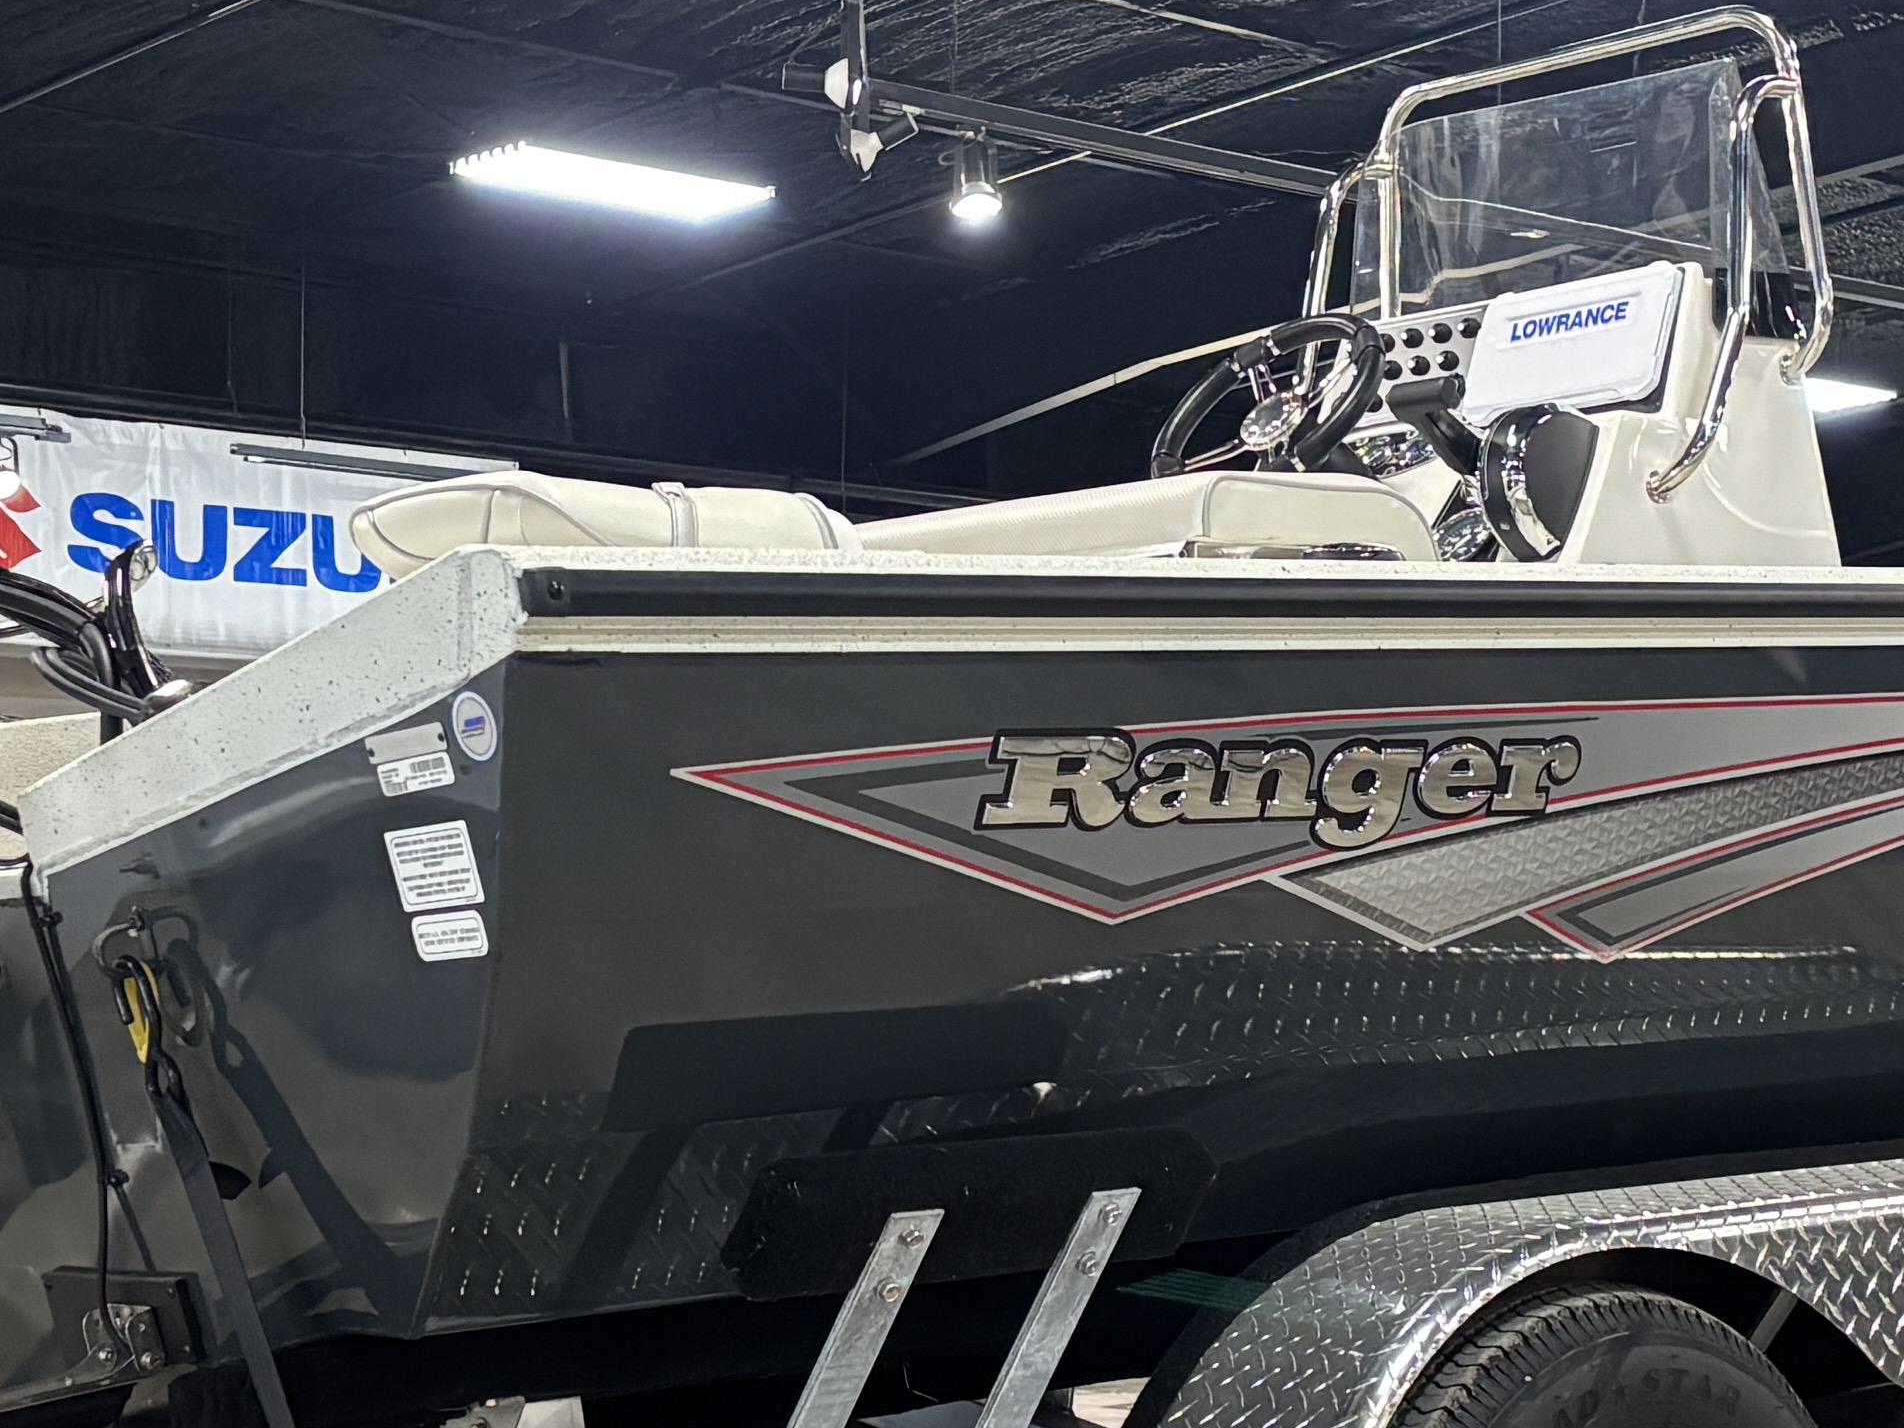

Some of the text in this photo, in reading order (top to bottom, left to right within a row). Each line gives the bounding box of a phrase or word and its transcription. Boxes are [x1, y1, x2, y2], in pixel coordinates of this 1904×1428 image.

[1510, 301, 1629, 343] LOWRANCE
[67, 492, 398, 594] SUZU
[973, 727, 1582, 849] Ranger
[1641, 1367, 1742, 1417] STAR
